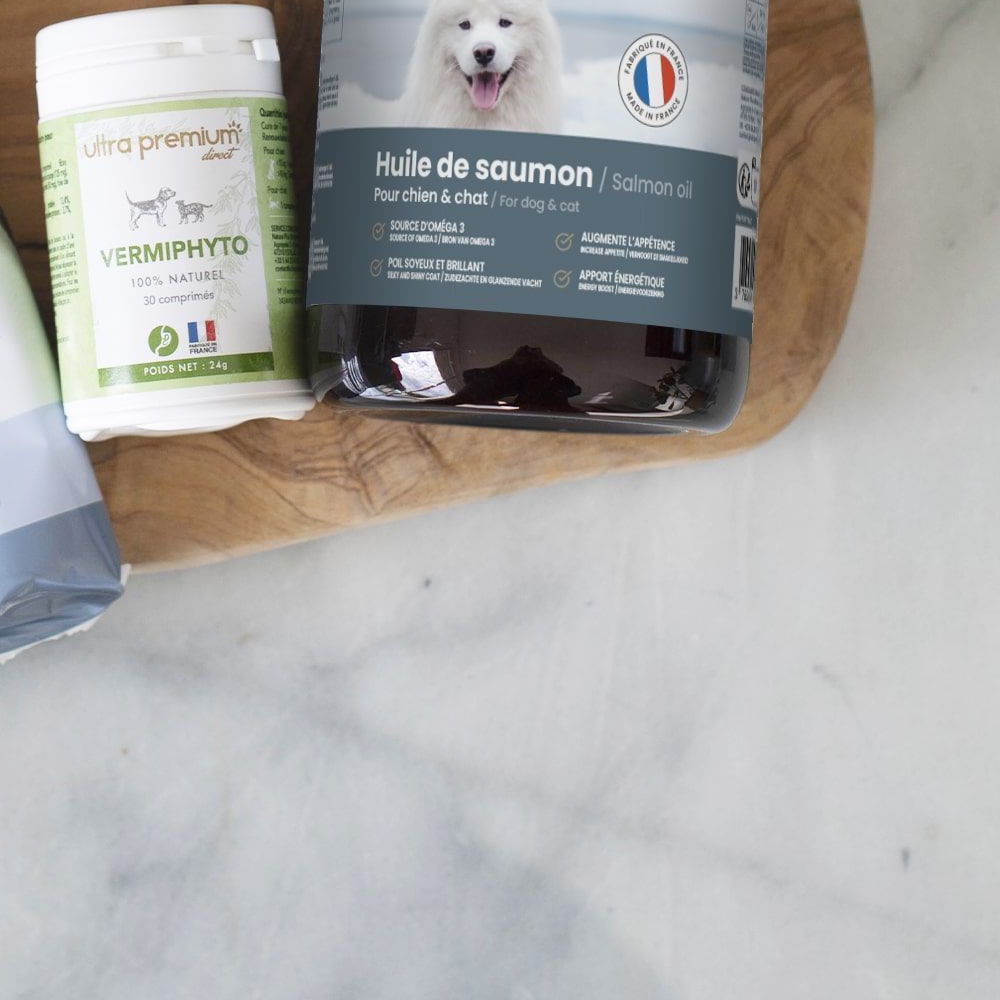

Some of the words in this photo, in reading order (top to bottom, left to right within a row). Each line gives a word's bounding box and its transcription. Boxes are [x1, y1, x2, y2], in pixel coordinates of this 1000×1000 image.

[624, 38, 653, 74] FABRIQUÉ
[655, 40, 666, 50] EN
[666, 46, 684, 81] FRANCE
[626, 91, 644, 116] MADE
[645, 111, 653, 120] IN
[655, 97, 681, 121] FRANCE
[83, 134, 131, 158] ultra
[138, 123, 240, 160] premium
[201, 147, 240, 161] direct
[375, 148, 432, 178] Huile
[436, 151, 470, 179] de
[475, 158, 593, 188] saumon
[612, 172, 673, 197] Salmon
[676, 180, 693, 200] oil
[374, 187, 400, 202] Pour
[402, 186, 438, 203] chien
[440, 188, 451, 204] &
[454, 189, 488, 206] chat
[500, 194, 517, 208] For
[520, 196, 545, 214] dog
[547, 199, 557, 211] &
[560, 200, 580, 213] cat
[390, 220, 419, 232] SOURCE
[460, 222, 465, 233] 3
[581, 231, 627, 246] AUGMENTE
[100, 235, 249, 268] VERMIPHYTO
[388, 257, 403, 268] POIL
[404, 258, 434, 269] SOYEUX
[436, 259, 446, 270] ET
[446, 260, 485, 272] BRILLANT
[131, 275, 164, 288] 100%
[168, 270, 225, 285] NATUREL
[522, 278, 543, 288] VACHT
[579, 269, 613, 282] APPORT
[614, 270, 665, 288] ÉNERGÉTIQUE
[143, 295, 155, 306] 30
[159, 290, 215, 305] comprimés
[144, 365, 174, 376] POIDS
[178, 362, 198, 372] NET
[209, 360, 228, 370] 24g
